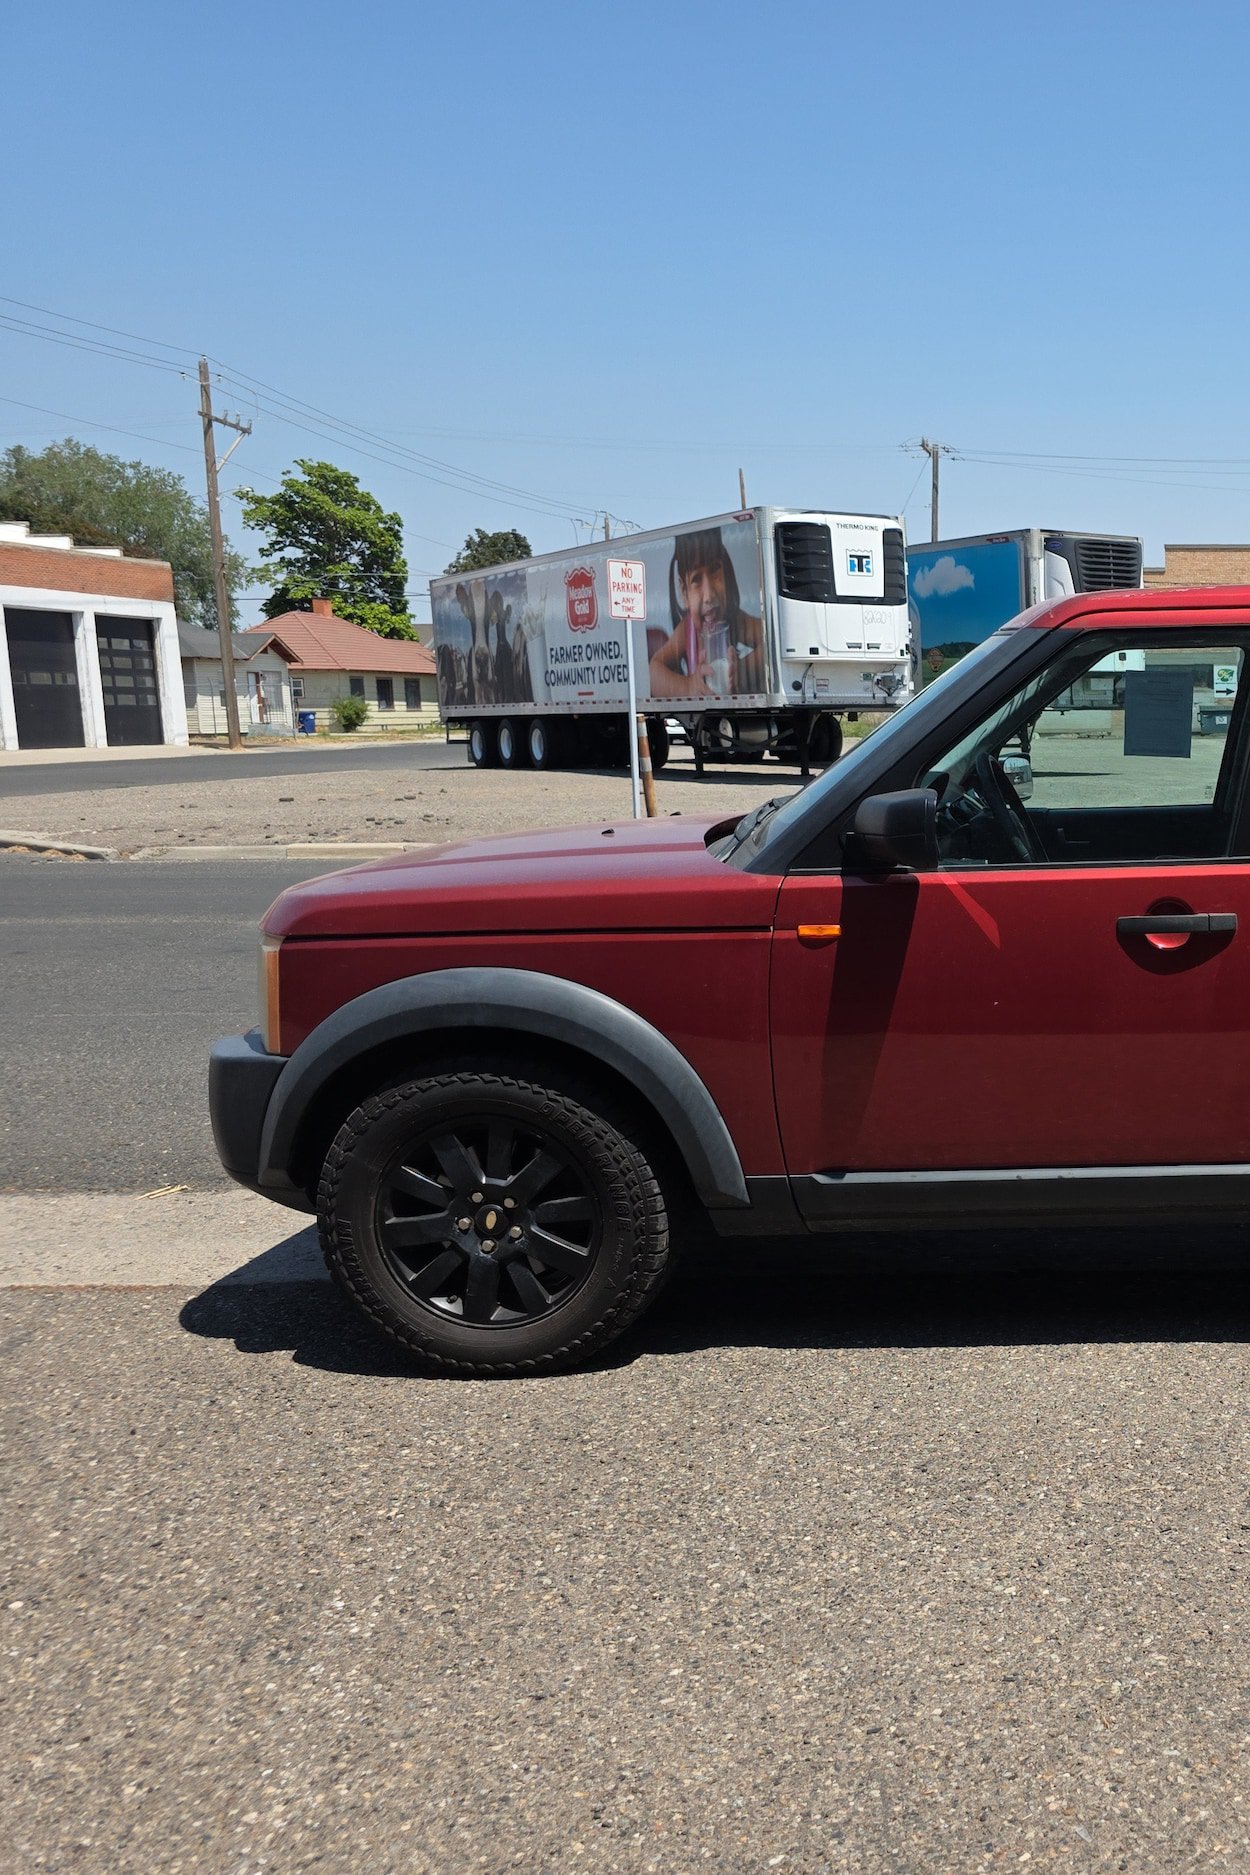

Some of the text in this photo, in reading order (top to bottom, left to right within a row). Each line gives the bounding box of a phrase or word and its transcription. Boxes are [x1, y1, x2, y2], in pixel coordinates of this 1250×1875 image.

[836, 523, 863, 531] THERMO
[621, 567, 633, 579] NO
[612, 581, 643, 594] PARKING
[575, 599, 590, 615] Gold
[549, 640, 623, 664] FARMER OWNED.
[544, 665, 596, 687] COMMUNITY
[539, 1101, 597, 1149] OPEN
[594, 1152, 632, 1234] RANGE
